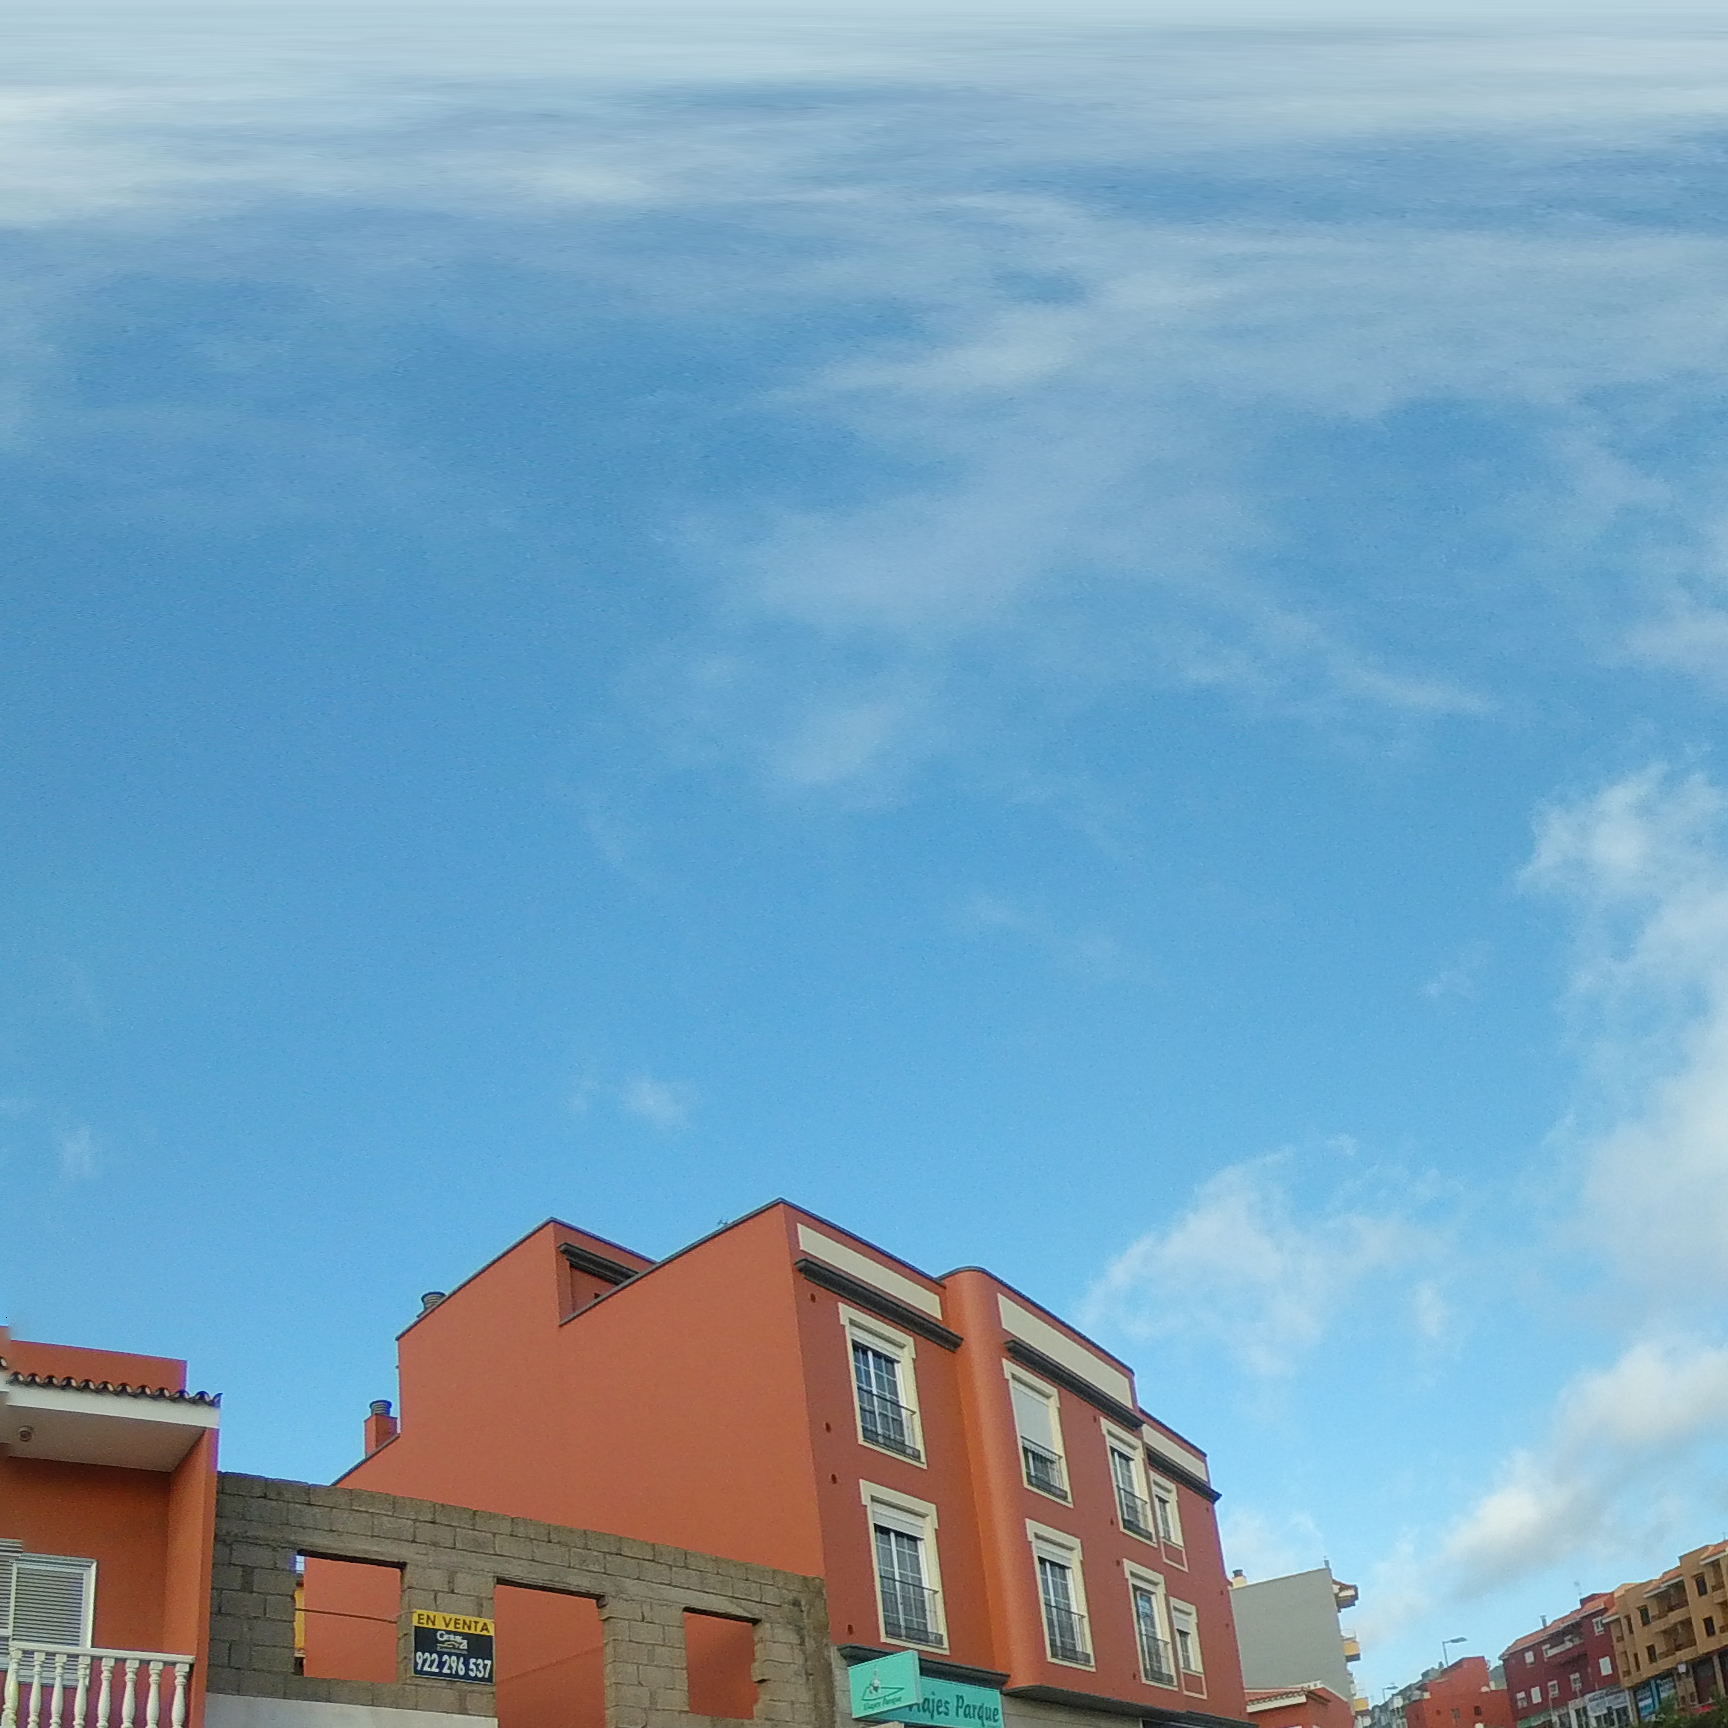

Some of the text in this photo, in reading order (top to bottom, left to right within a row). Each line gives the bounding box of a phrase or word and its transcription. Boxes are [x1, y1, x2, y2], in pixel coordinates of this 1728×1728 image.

[417, 1613, 490, 1634] EN VENTA
[416, 1651, 492, 1678] 922 296 537
[955, 1694, 1000, 1728] Parque
